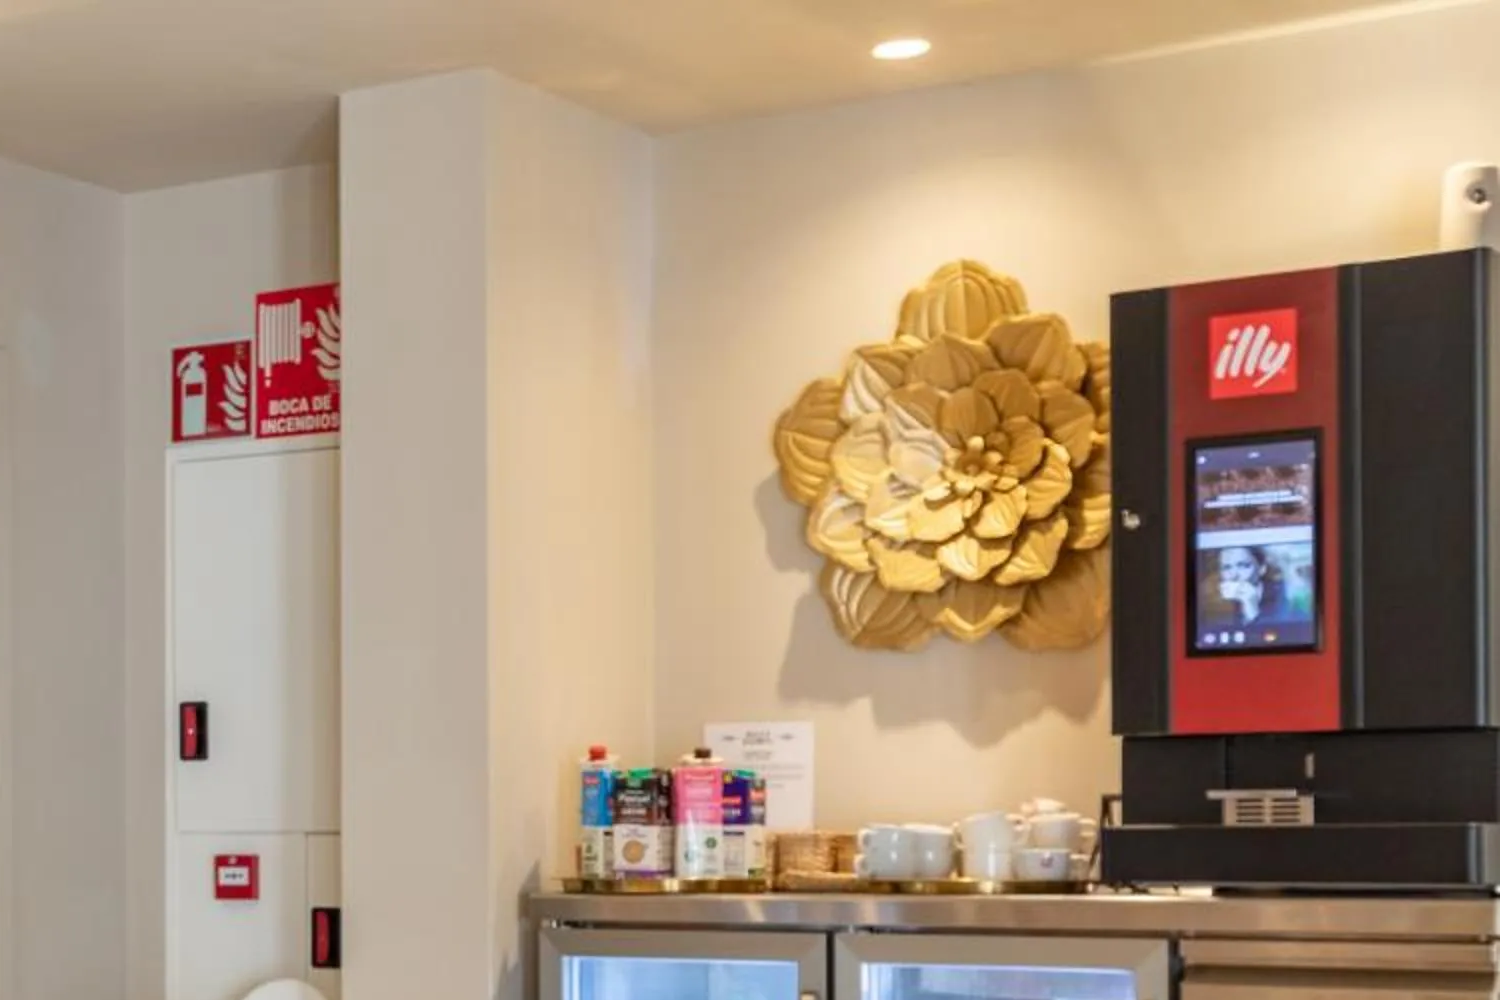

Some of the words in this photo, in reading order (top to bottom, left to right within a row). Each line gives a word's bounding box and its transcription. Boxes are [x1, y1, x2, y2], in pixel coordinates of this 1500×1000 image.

[1214, 323, 1291, 388] illy
[268, 397, 309, 416] BOCA
[312, 394, 332, 411] DE
[260, 412, 340, 434] INCENDIOS
